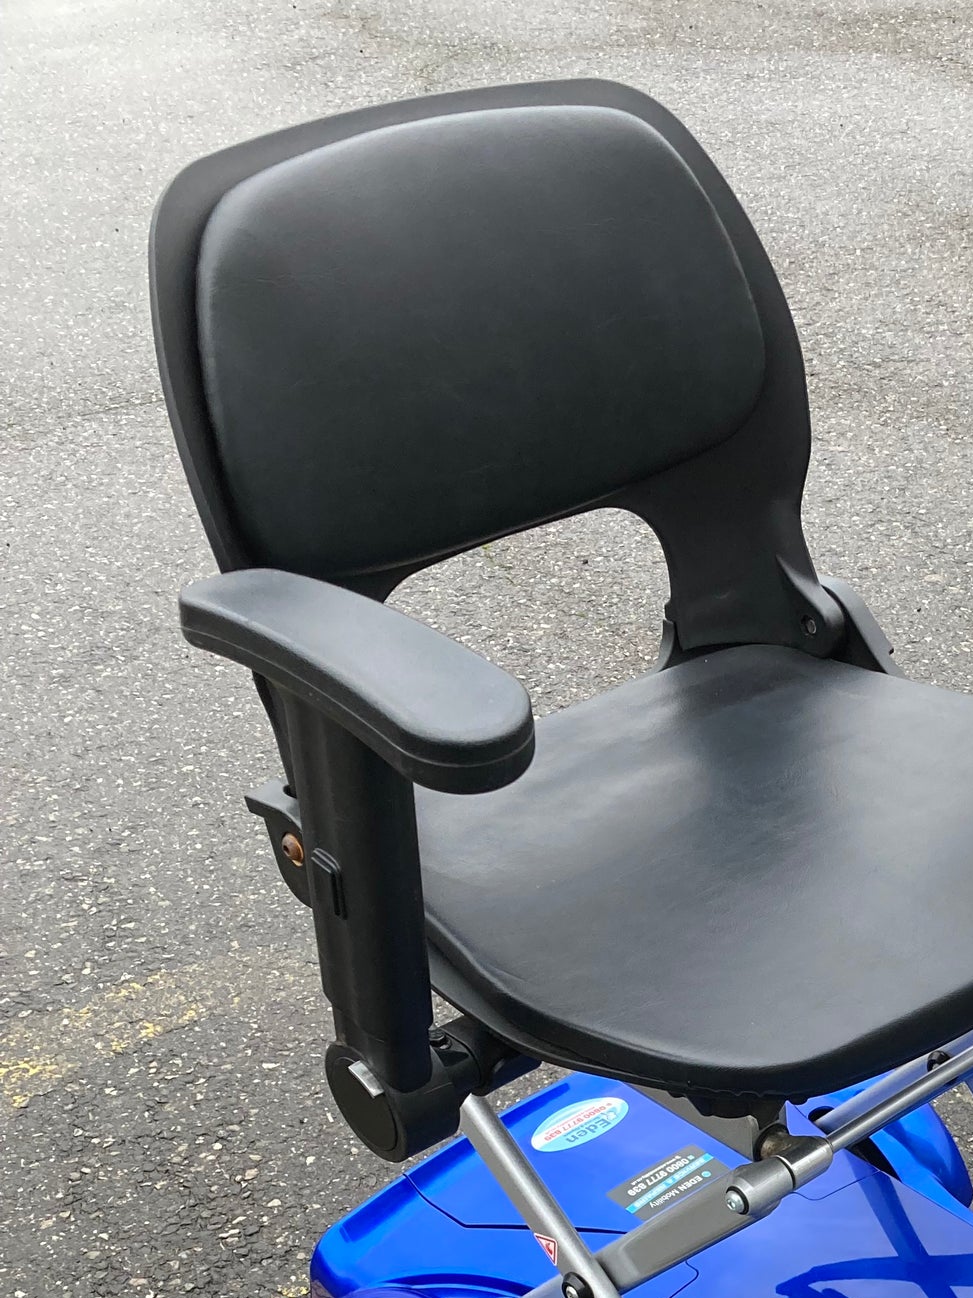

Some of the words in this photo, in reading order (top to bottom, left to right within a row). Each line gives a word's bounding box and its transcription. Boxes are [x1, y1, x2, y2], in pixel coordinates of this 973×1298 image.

[584, 1105, 606, 1119] 0800
[563, 1118, 584, 1131] 9777
[566, 1118, 611, 1143] Eden
[665, 1158, 689, 1173] 0800
[645, 1171, 668, 1186] 9777
[678, 1175, 703, 1192] EDEN
[627, 1184, 647, 1197] 839
[650, 1190, 679, 1208] Mobility
